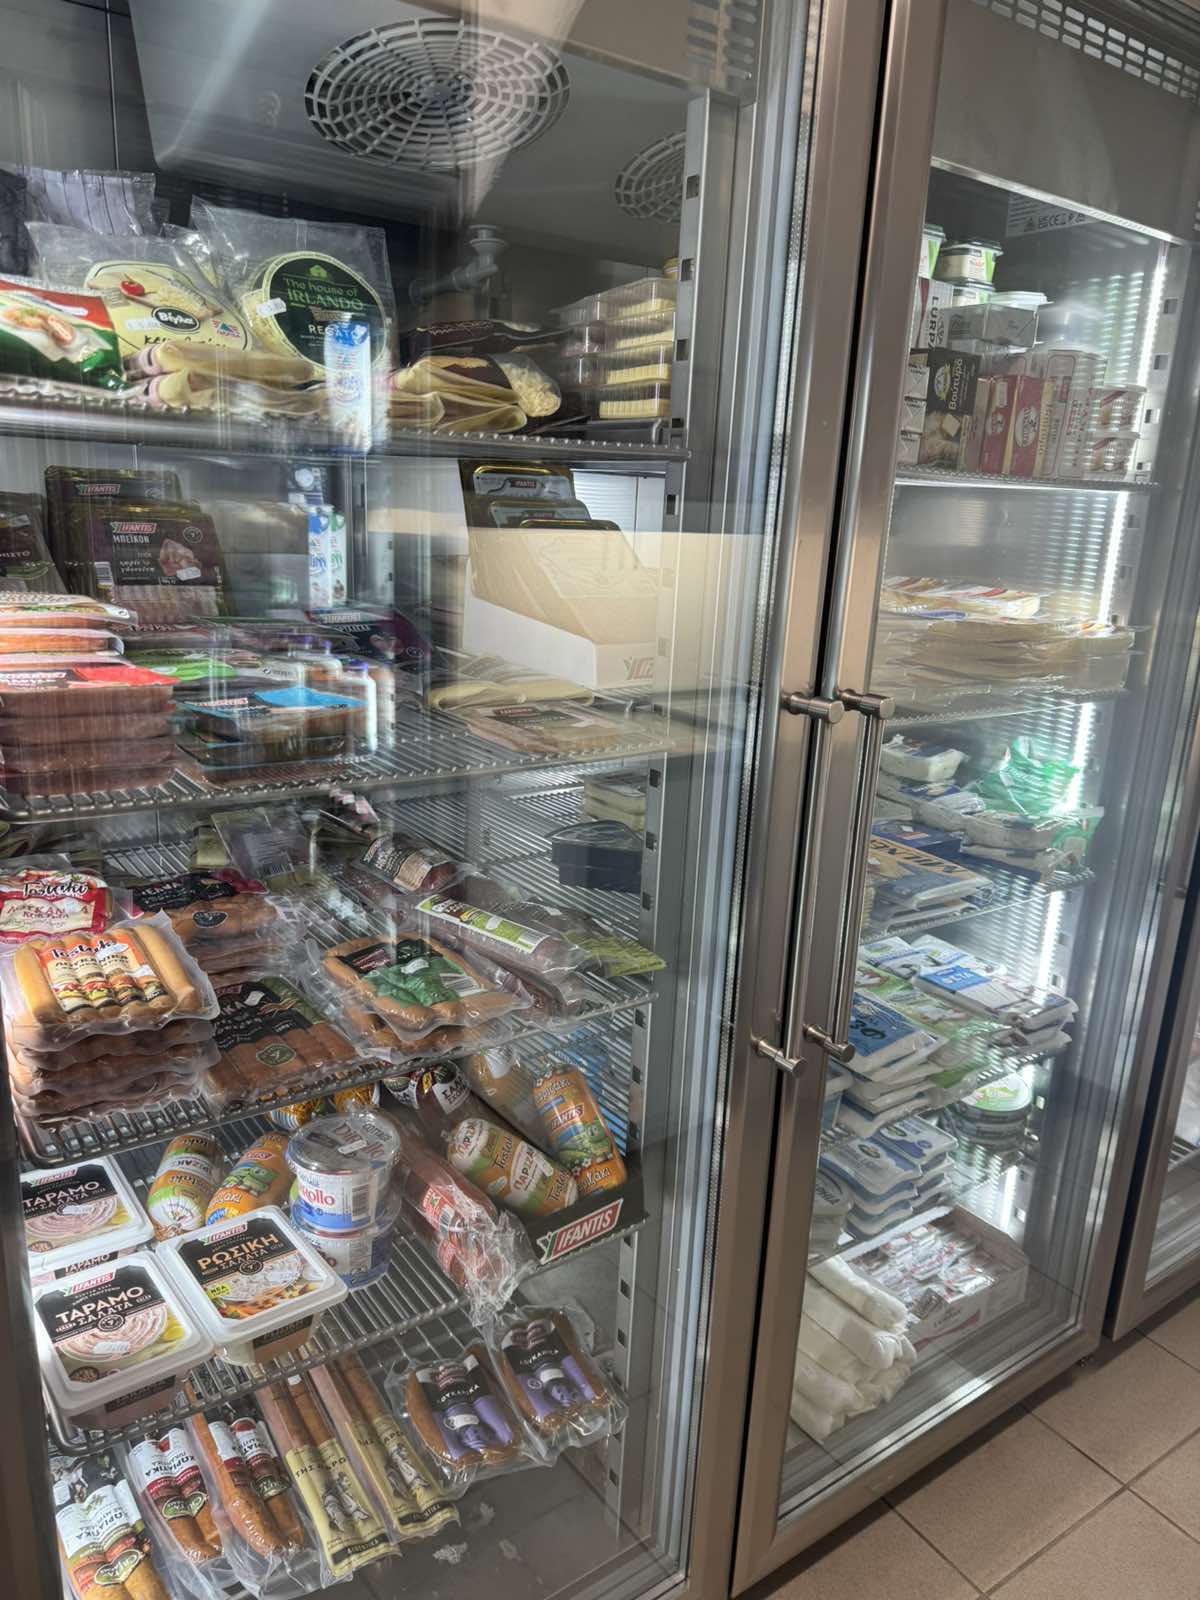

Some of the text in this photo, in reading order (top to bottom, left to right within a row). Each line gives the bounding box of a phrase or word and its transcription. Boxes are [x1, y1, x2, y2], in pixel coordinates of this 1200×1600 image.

[23, 1181, 100, 1208] ΤΑΡΑΜΟ
[556, 1209, 613, 1251] IFANTIS
[197, 1233, 279, 1270] ΡΩΣΙΚΗ
[55, 1286, 144, 1323] ΤΑΡΑΜΟ
[77, 1301, 133, 1325] ΣΑΛΑΤΑ
